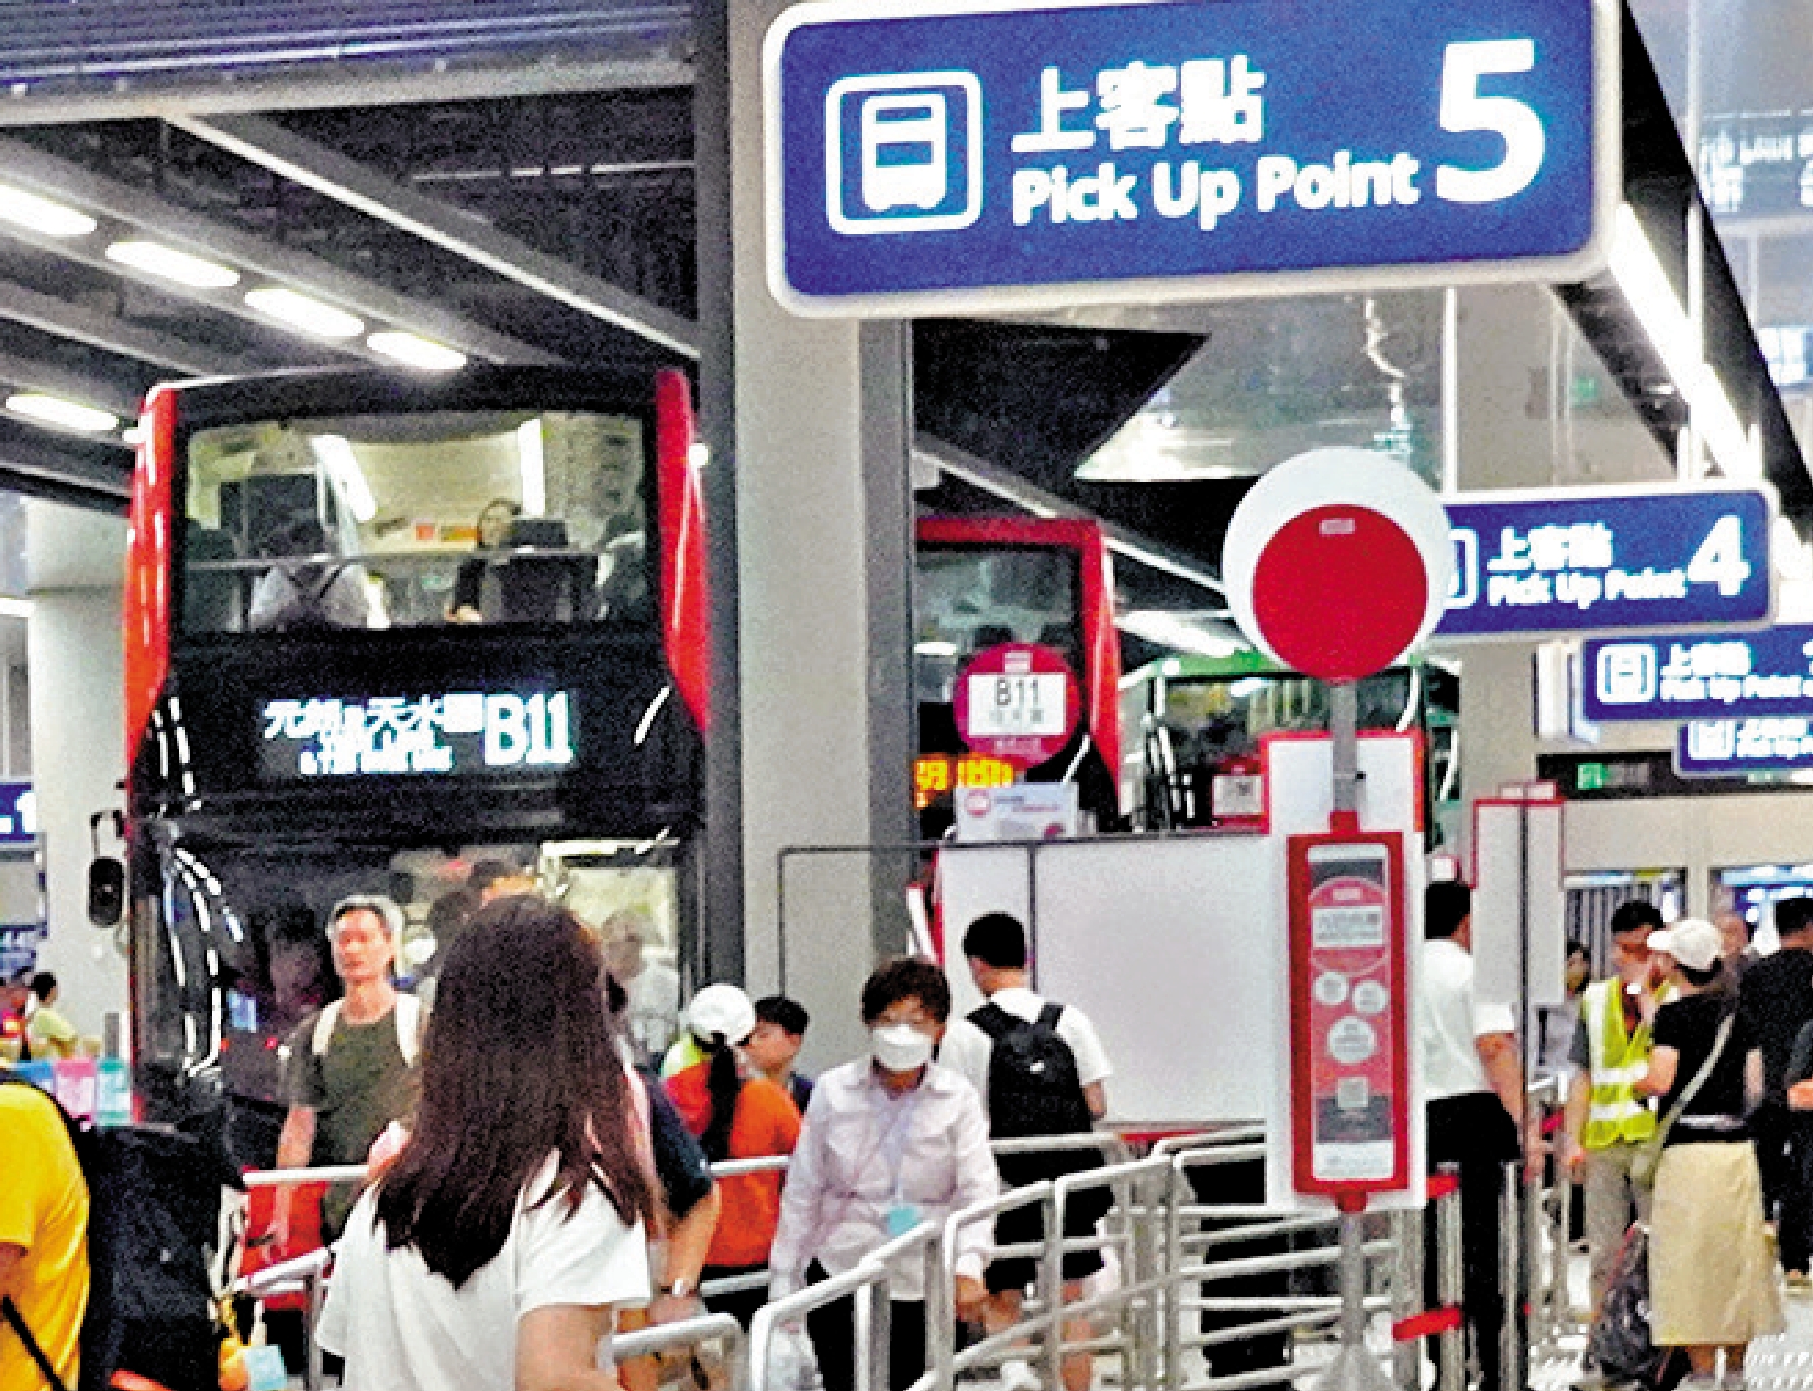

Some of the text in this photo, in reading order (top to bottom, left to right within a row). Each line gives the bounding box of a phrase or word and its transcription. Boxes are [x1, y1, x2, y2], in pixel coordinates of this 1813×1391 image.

[1012, 55, 1265, 154] 上客點
[1013, 38, 1545, 231] Pick Up Point 5
[1688, 515, 1751, 596] 4
[485, 690, 574, 764] B11
